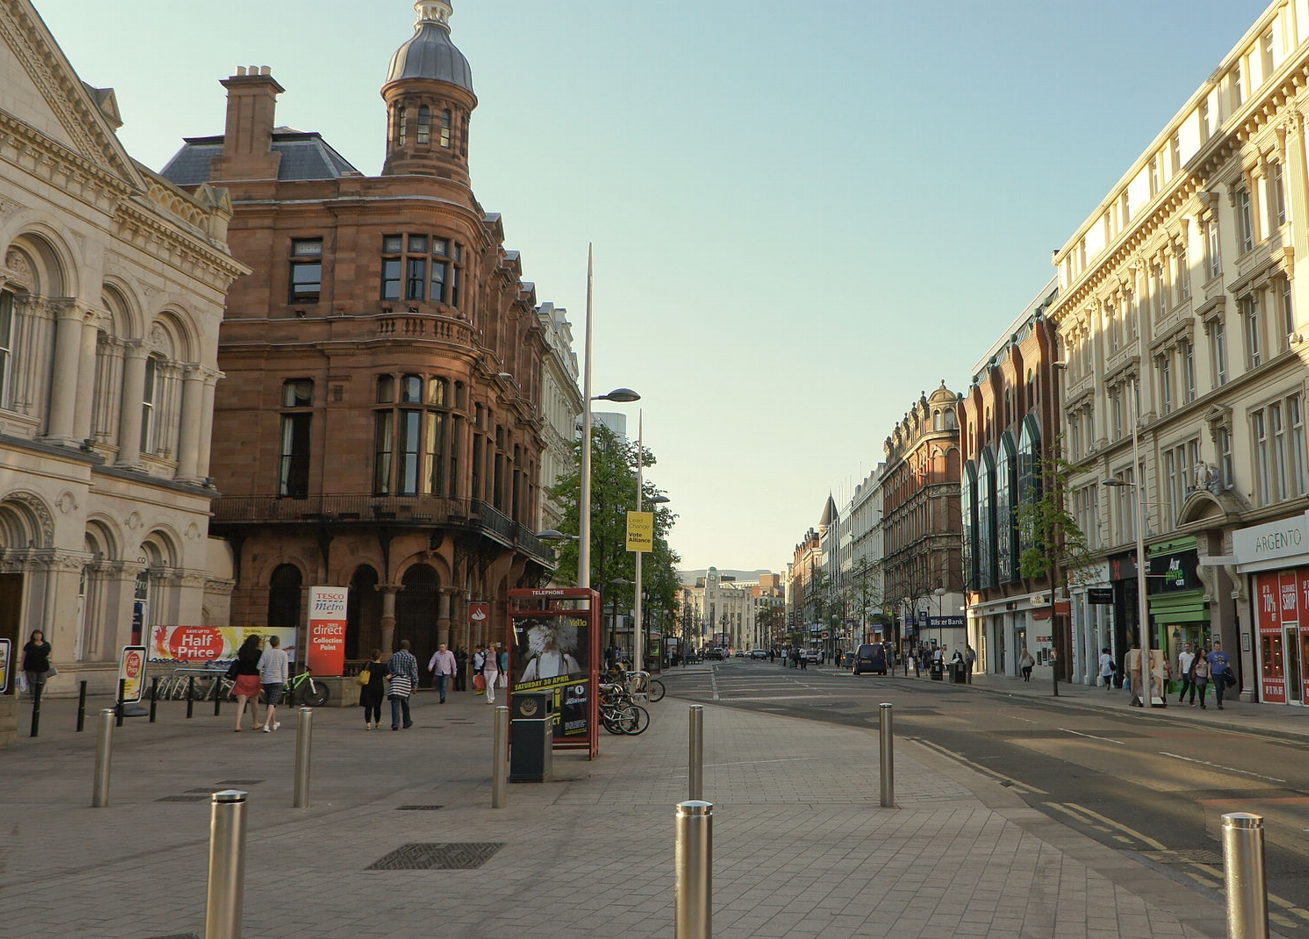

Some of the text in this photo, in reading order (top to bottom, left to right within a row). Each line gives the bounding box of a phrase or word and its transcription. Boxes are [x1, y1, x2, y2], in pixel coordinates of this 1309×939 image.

[1255, 528, 1302, 553] ARGENTO
[314, 602, 345, 611] Metro
[1282, 593, 1296, 610] SHOP
[313, 624, 343, 635] direct
[182, 634, 213, 647] Half
[178, 646, 215, 658] Price
[515, 681, 542, 690] SATURDAY
[552, 675, 569, 684] APRIL
